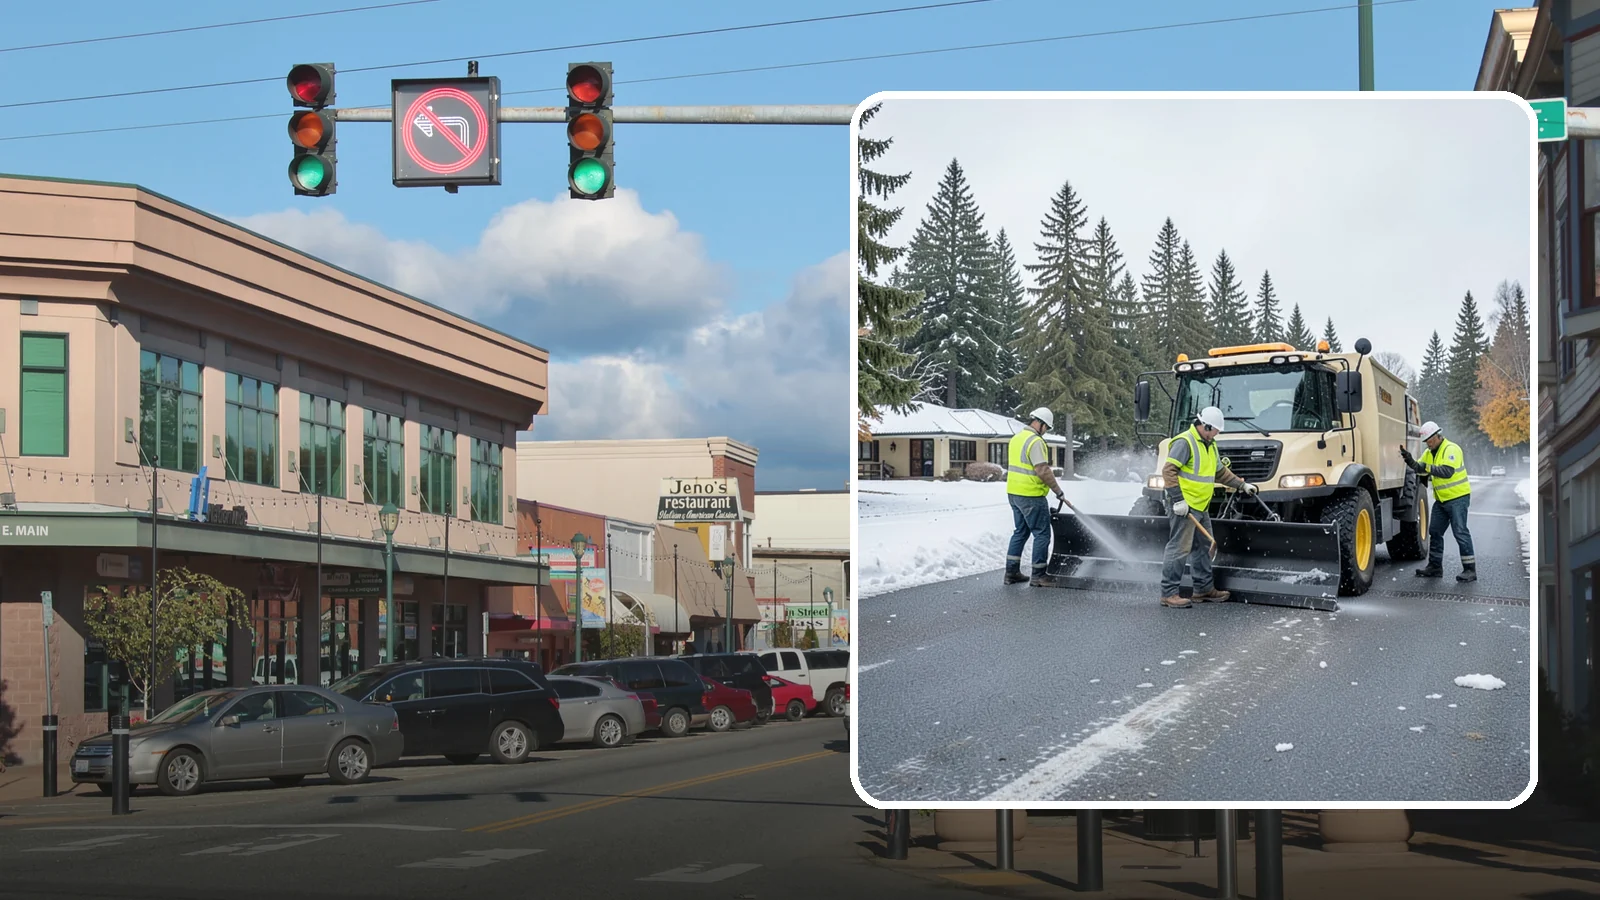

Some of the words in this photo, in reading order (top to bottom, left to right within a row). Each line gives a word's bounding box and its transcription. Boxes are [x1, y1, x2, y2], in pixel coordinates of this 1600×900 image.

[670, 480, 727, 494] Jeno's
[665, 497, 731, 509] restaurant
[658, 510, 681, 519] Italian
[686, 510, 714, 519] American
[715, 509, 737, 519] Cuisine
[2, 525, 13, 536] E.
[15, 525, 49, 536] MAIN
[797, 607, 829, 617] Street
